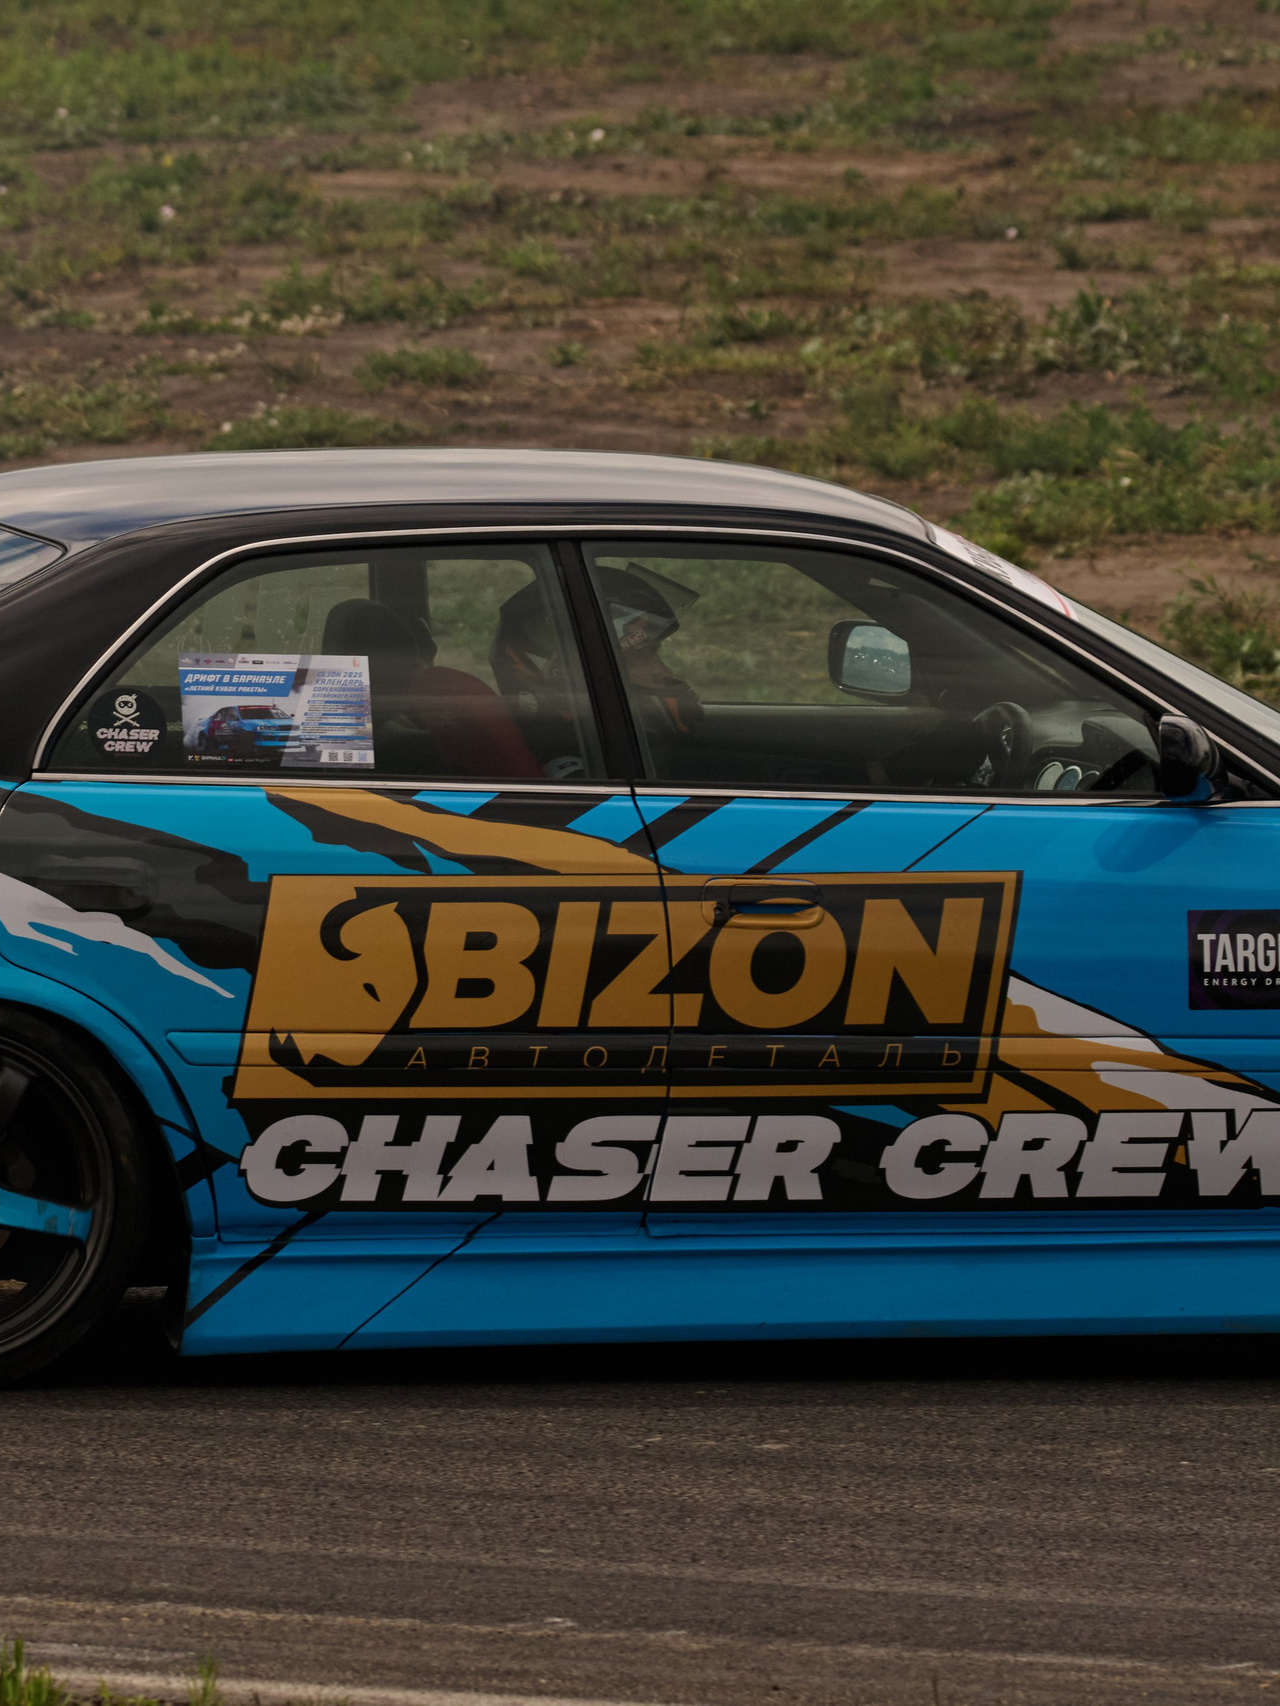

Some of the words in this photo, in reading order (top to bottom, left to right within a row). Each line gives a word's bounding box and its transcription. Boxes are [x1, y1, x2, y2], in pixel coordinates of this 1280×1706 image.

[184, 673, 222, 683] ДРИФТ
[223, 674, 230, 683] В
[232, 675, 287, 684] БАРНАУЛЕ
[315, 679, 364, 687] КАЛЕНДАРЬ
[96, 728, 160, 740] CHASER
[104, 741, 153, 752] CREW
[1197, 933, 1280, 973] TARG
[409, 897, 985, 1029] BIZON
[1203, 978, 1257, 986] ENERGY
[404, 1043, 963, 1074] АВТОДЕТАЛЬ
[239, 1113, 842, 1202] CHASER
